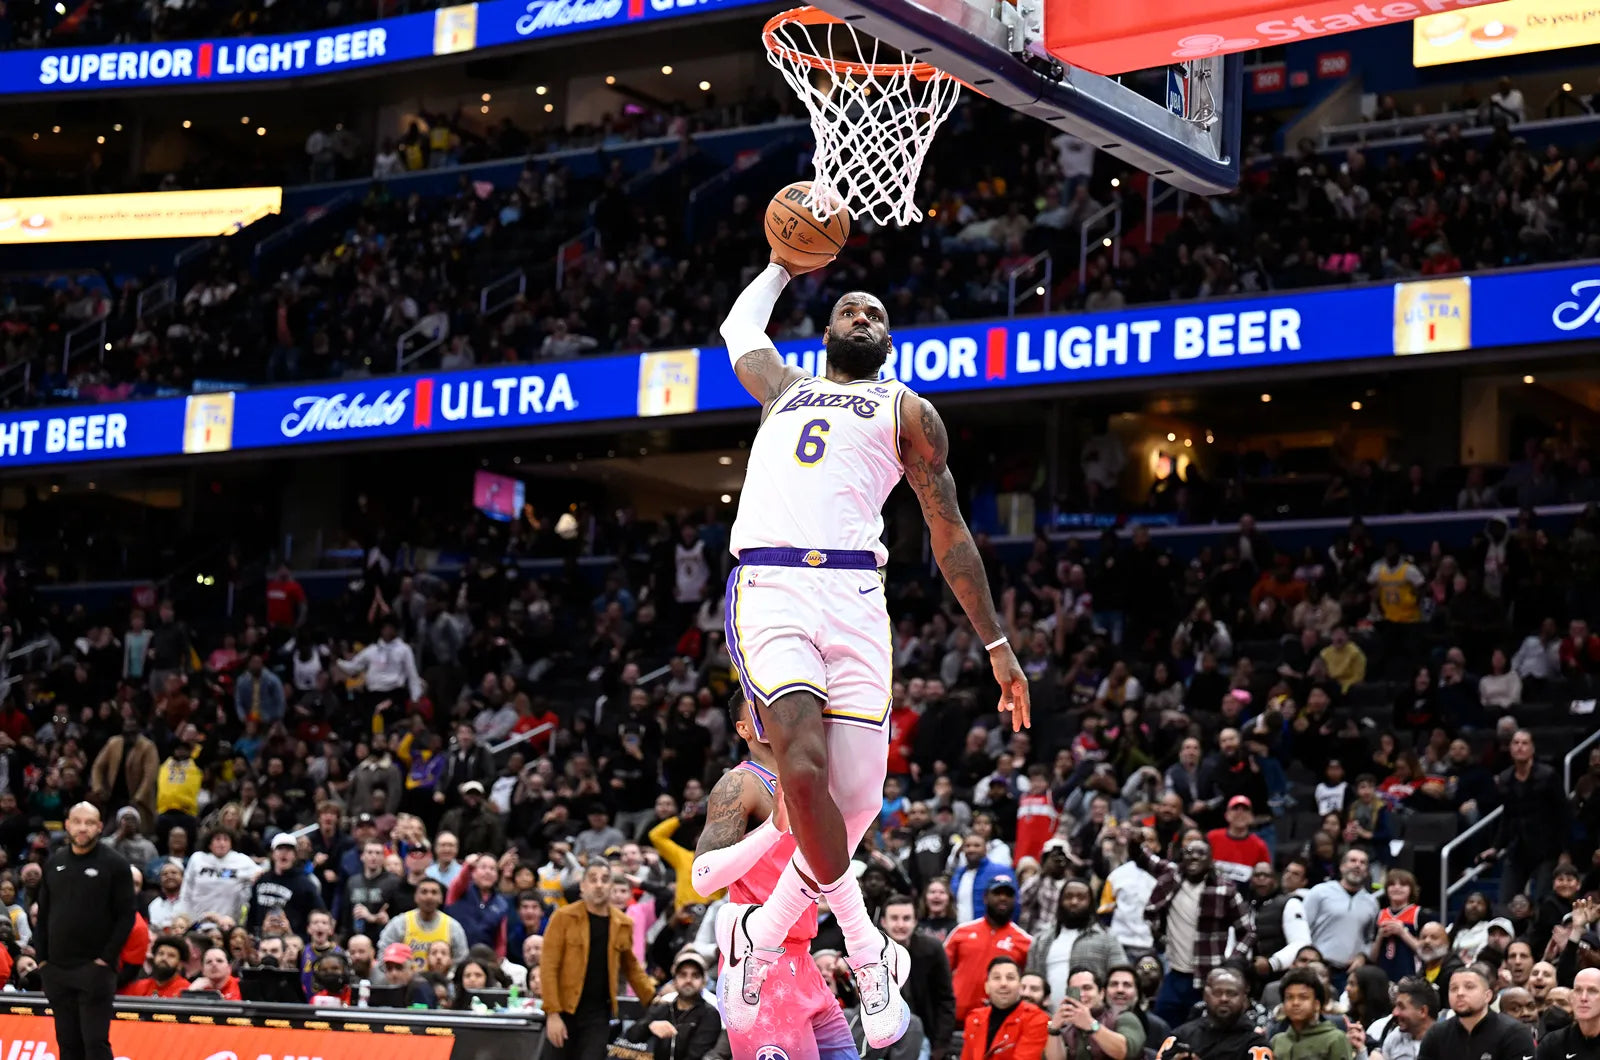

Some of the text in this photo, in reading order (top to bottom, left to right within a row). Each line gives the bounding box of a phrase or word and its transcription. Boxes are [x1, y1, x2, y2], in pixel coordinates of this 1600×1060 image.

[1255, 1, 1421, 41] State
[39, 28, 387, 85] SUPERIOR LIGHT BEER
[1016, 320, 1160, 373] LIGHT
[1173, 308, 1302, 360] BEER
[281, 373, 573, 438] Michelob ULTRA
[775, 388, 880, 418] LAKERS
[0, 413, 127, 457] HT BEER
[794, 418, 830, 468] 6
